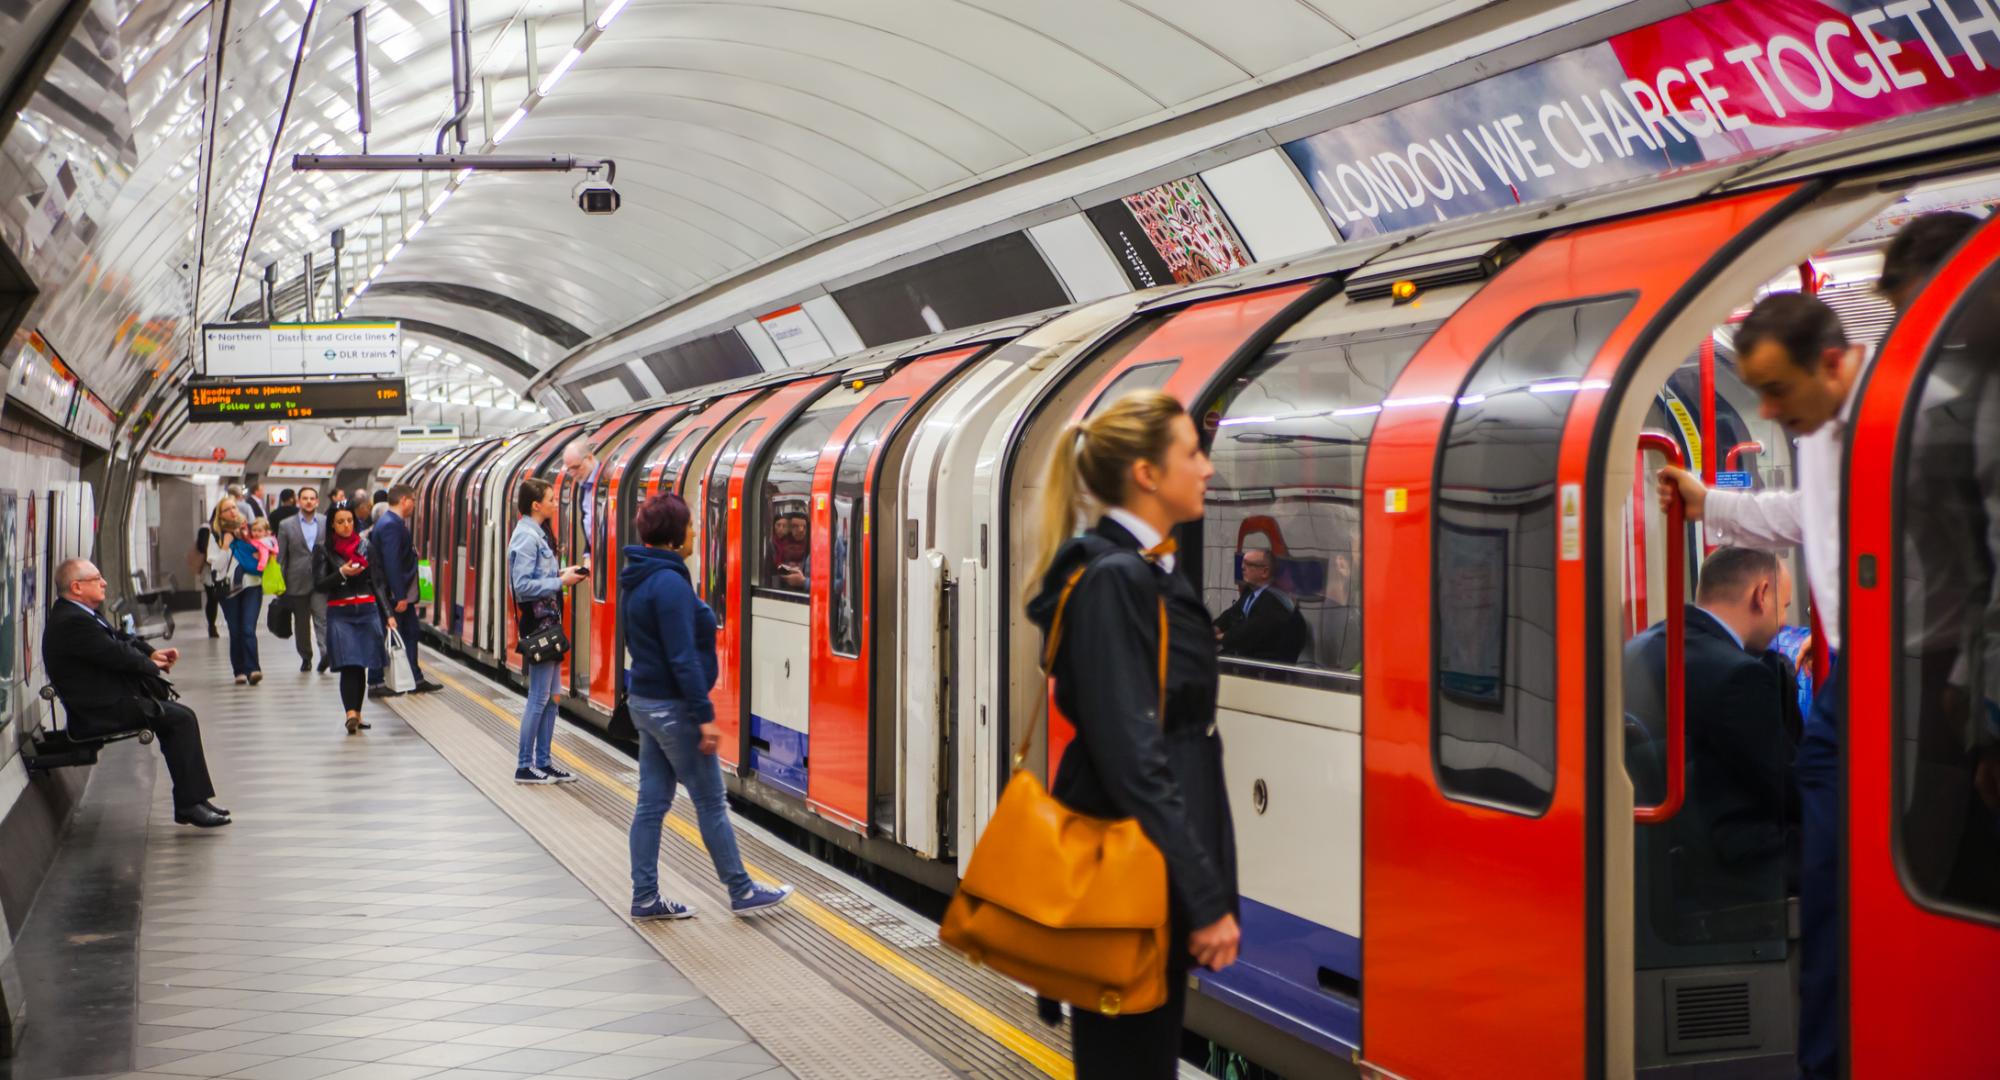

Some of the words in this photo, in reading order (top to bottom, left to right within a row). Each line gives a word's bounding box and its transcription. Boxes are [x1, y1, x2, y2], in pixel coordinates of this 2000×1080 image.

[1317, 133, 1486, 221] LONDON
[1462, 114, 1556, 186] WE
[1538, 57, 1751, 169] CHARGE
[1723, 0, 2000, 119] TOGETH
[218, 333, 262, 341] Northern
[277, 333, 312, 342] District
[316, 333, 333, 342] and
[335, 332, 362, 342] Circle
[365, 332, 387, 341] lines
[218, 343, 236, 351] line
[339, 350, 358, 359] DLR
[361, 350, 388, 359] trains
[262, 385, 301, 396] Hainault
[200, 395, 231, 405] Epping
[220, 402, 250, 412] Follow
